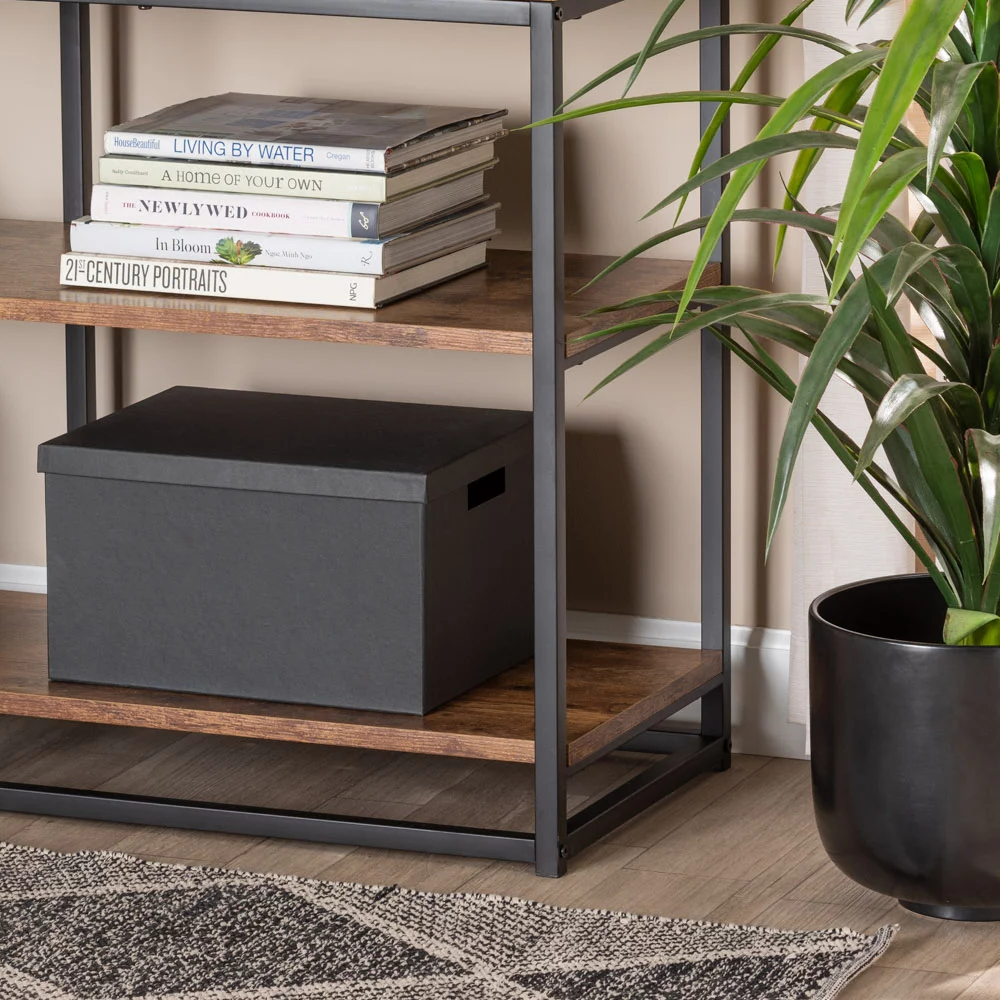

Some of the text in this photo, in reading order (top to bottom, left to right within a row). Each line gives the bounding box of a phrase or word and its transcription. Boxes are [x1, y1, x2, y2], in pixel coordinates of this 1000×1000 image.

[113, 136, 351, 162] HouseBeautiful LIVING BY WATER Cregan
[161, 169, 172, 182] A
[224, 174, 241, 186] OF
[287, 178, 323, 192] OWN
[139, 199, 248, 219] NEWLYWED
[251, 211, 291, 220] COOKBOOK
[155, 237, 313, 261] In Bloom Ngoc Minh Ngo
[86, 259, 150, 288] CENTURY
[153, 265, 228, 294] PORTRAITS
[349, 282, 358, 302] NPG
